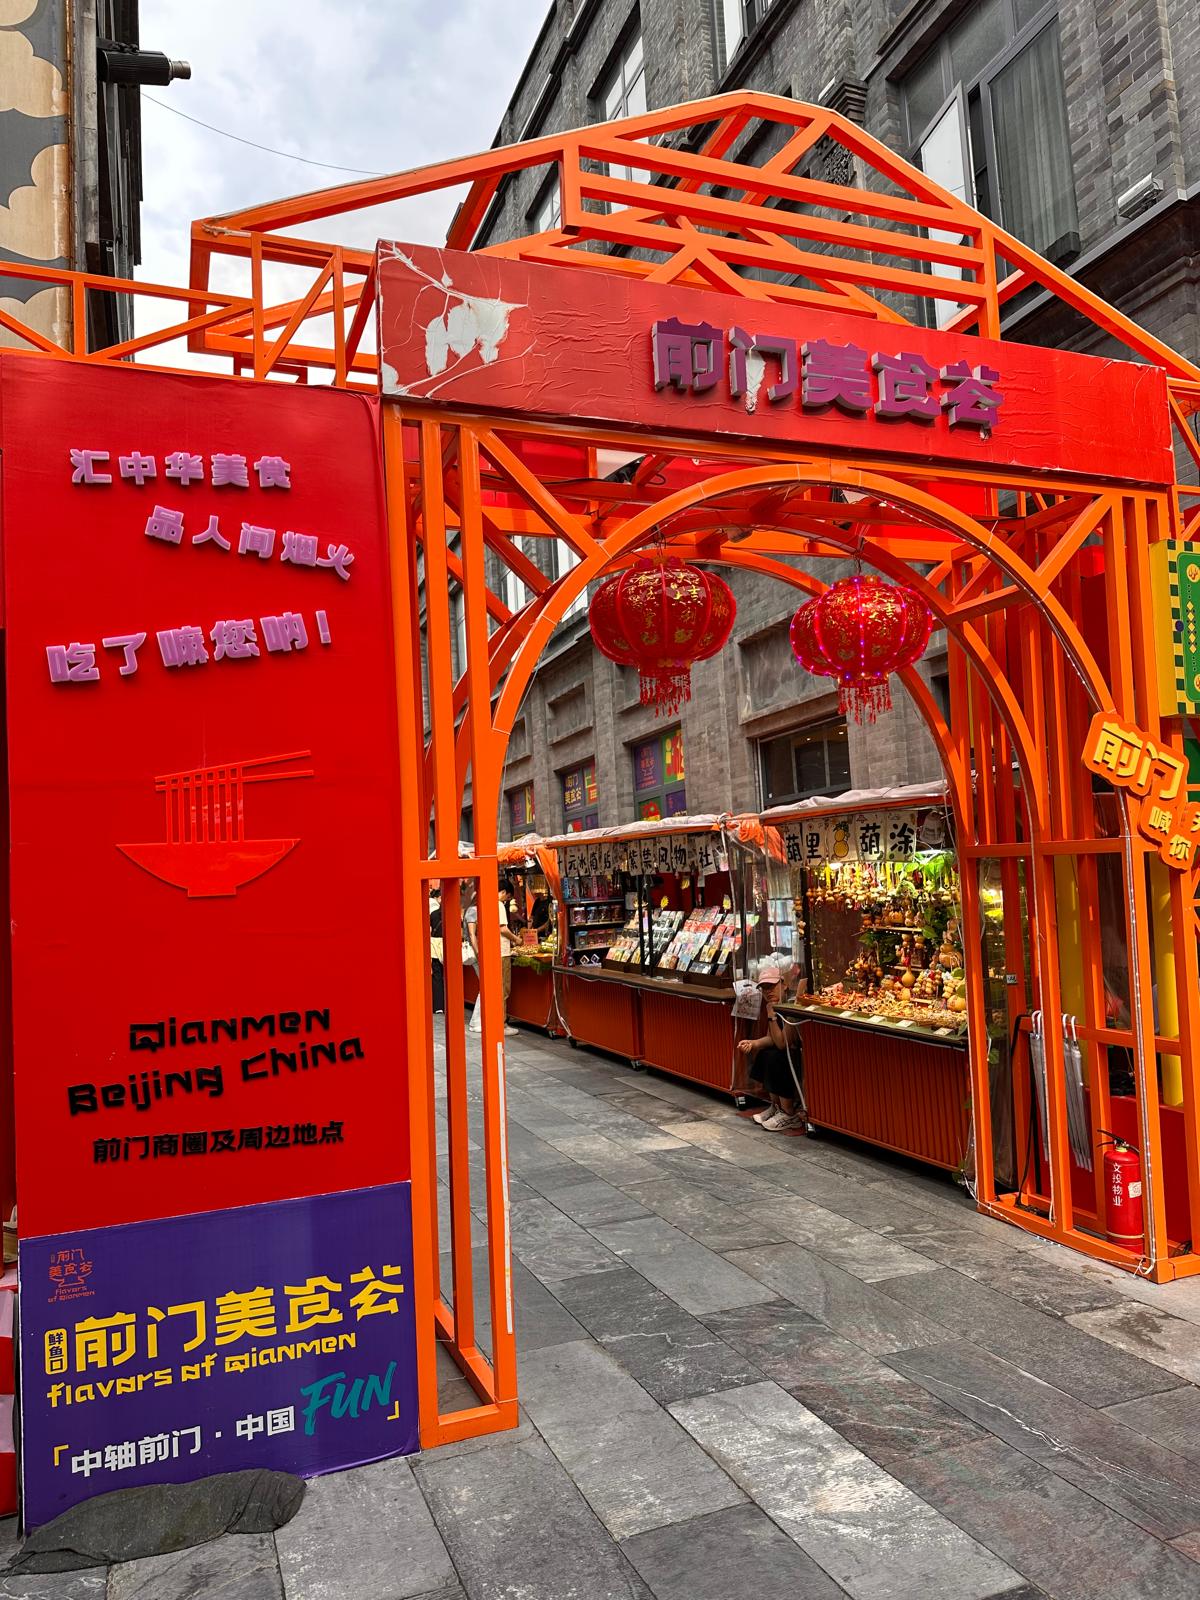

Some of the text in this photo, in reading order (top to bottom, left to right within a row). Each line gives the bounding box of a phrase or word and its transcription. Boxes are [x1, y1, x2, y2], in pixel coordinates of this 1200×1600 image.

[70, 448, 292, 489] 汇中华美食
[145, 505, 355, 581] 品人间烟火
[46, 609, 331, 682] 吃了嘛您呐！
[1094, 721, 1185, 799] 前门
[129, 1008, 330, 1052] Qianmen
[67, 1037, 365, 1115] Beijing China
[93, 1120, 345, 1163] 前门商圈及周边地点
[47, 1331, 66, 1372] 鲜鱼口
[75, 1264, 405, 1373] 前门美食荟
[47, 1332, 356, 1407] flavors of Qianmen
